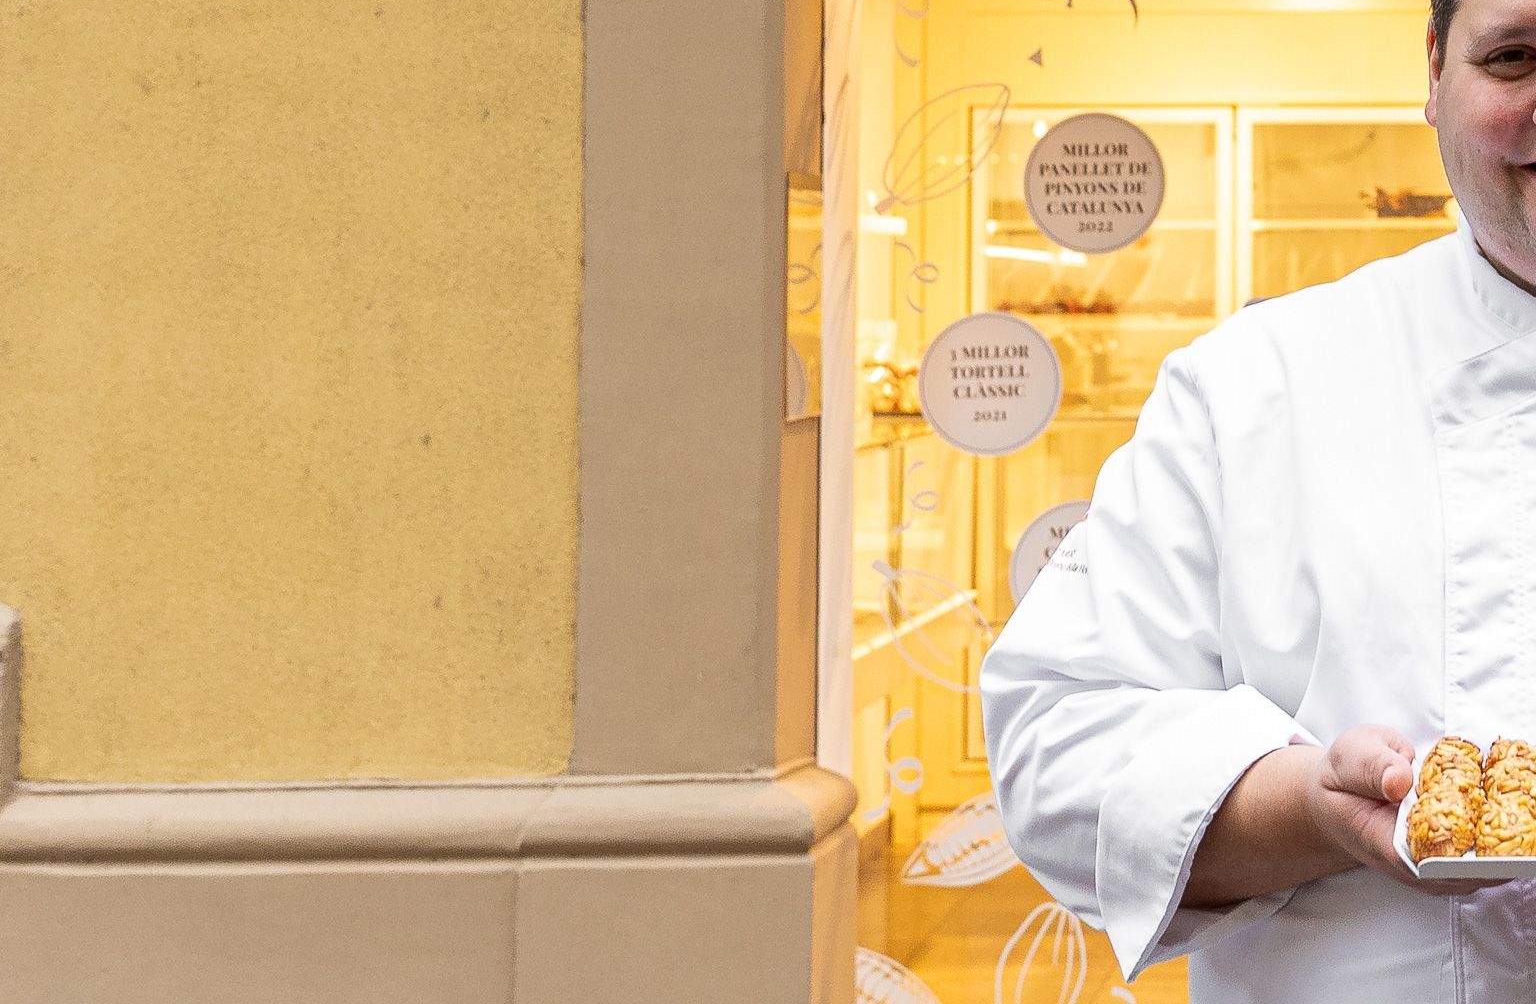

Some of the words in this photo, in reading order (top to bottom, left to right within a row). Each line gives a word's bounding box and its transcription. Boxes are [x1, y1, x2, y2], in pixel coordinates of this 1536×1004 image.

[1063, 143, 1129, 156] MILLOR
[1039, 161, 1125, 176] PANELLET
[1129, 162, 1148, 175] DE
[1044, 181, 1119, 195] PINYONS
[1123, 182, 1143, 194] DE
[1046, 200, 1145, 214] CATALUNYA
[1078, 220, 1114, 233] 2022
[962, 344, 1029, 358] MILLOR
[951, 364, 1029, 379] TORTELL
